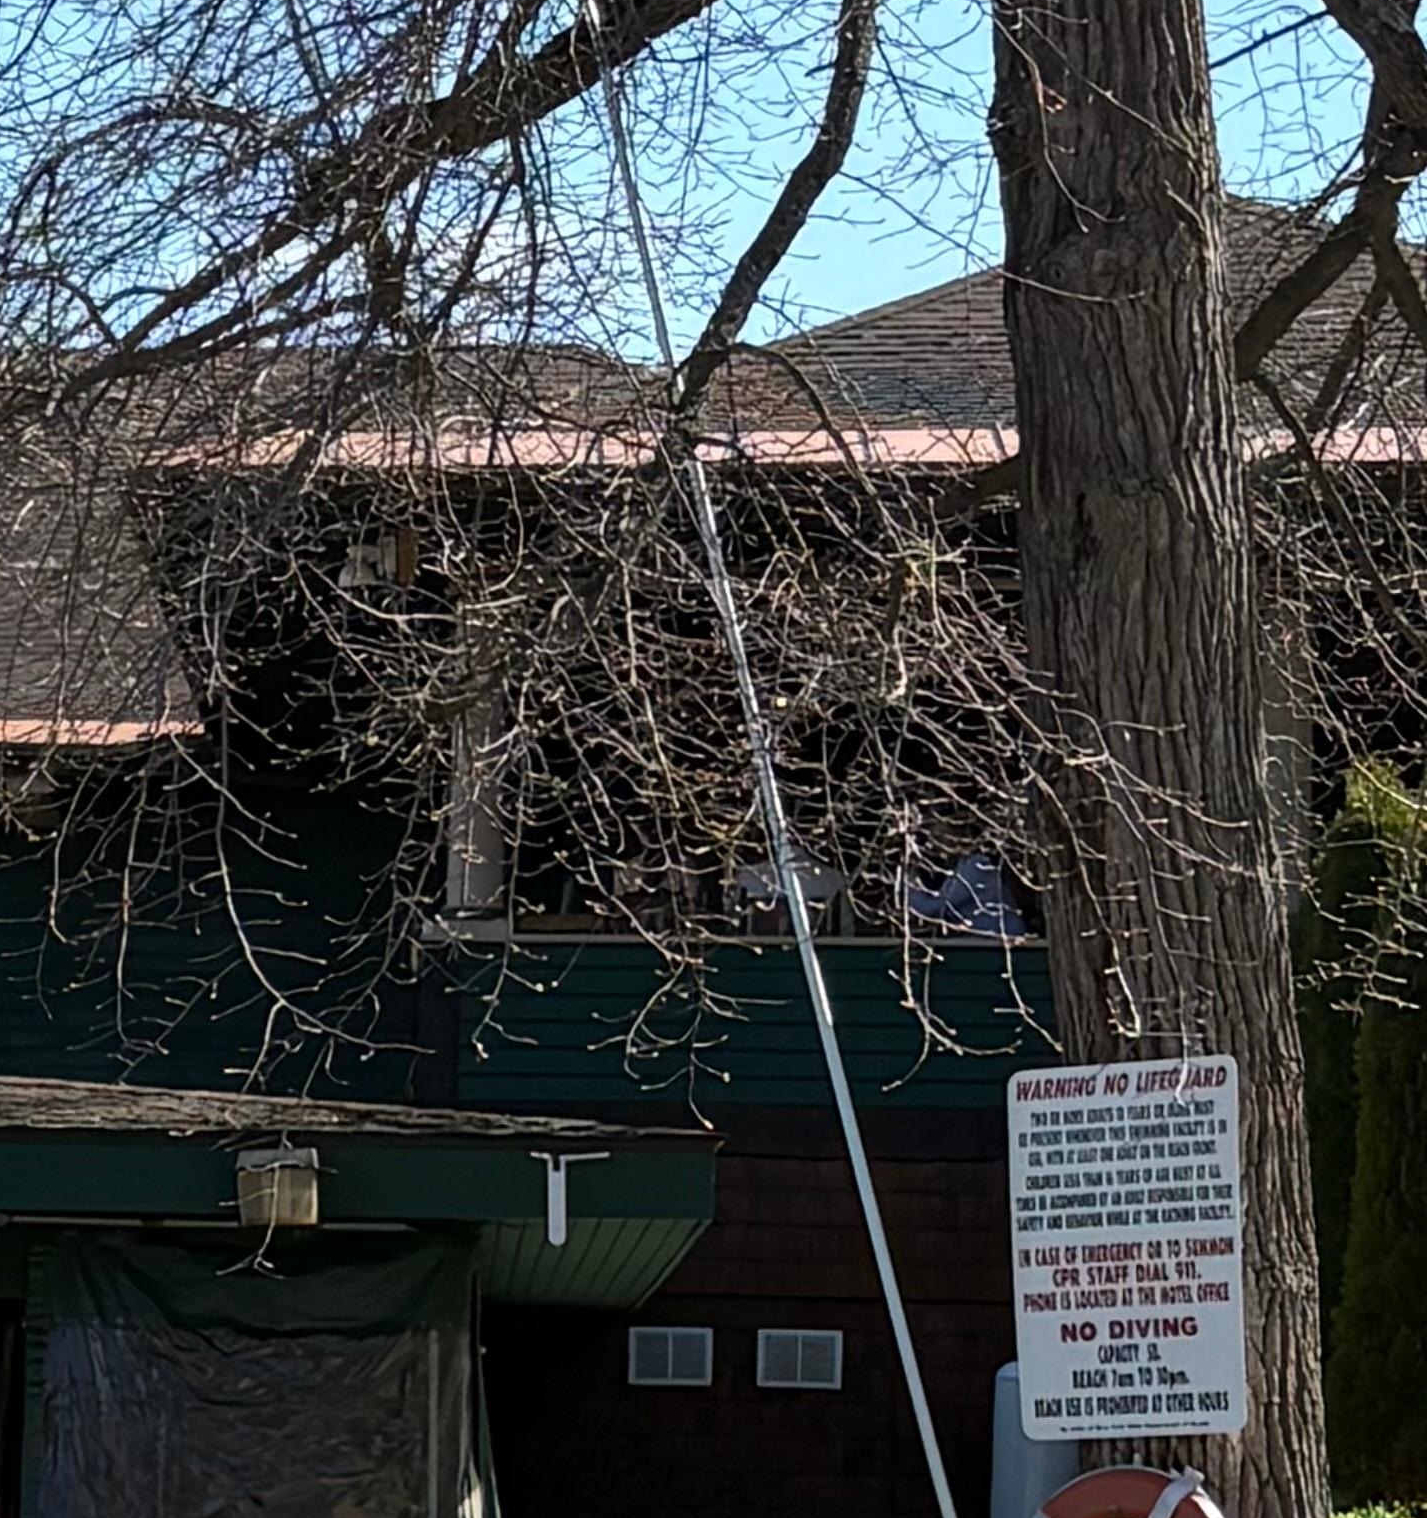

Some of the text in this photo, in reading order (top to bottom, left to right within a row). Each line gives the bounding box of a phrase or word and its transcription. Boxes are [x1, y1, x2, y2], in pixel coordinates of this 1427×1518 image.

[1015, 1074, 1096, 1101] WARNING
[1102, 1072, 1128, 1095] NO
[1116, 1169, 1140, 1184] YEARS
[1018, 1235, 1234, 1267] IN CASE OF EMERGENCY OR TO SUMMON
[1052, 1260, 1201, 1287] CPR STAFF DIAL 911.
[1023, 1291, 1056, 1312] PHONE
[1059, 1291, 1070, 1310] IS
[1074, 1288, 1116, 1309] LOCATED
[1121, 1287, 1133, 1307] AT
[1137, 1286, 1155, 1306] THE
[1196, 1282, 1229, 1303] OFFICE
[1060, 1315, 1198, 1342] NO DIVING
[1098, 1343, 1139, 1364] CAPACITY
[1072, 1368, 1107, 1389] BEACH
[1111, 1367, 1134, 1387] 7am
[1137, 1366, 1152, 1386] TO
[1034, 1390, 1228, 1418] BEACH USE IS PROHIBITED AT OTHER HOURS
